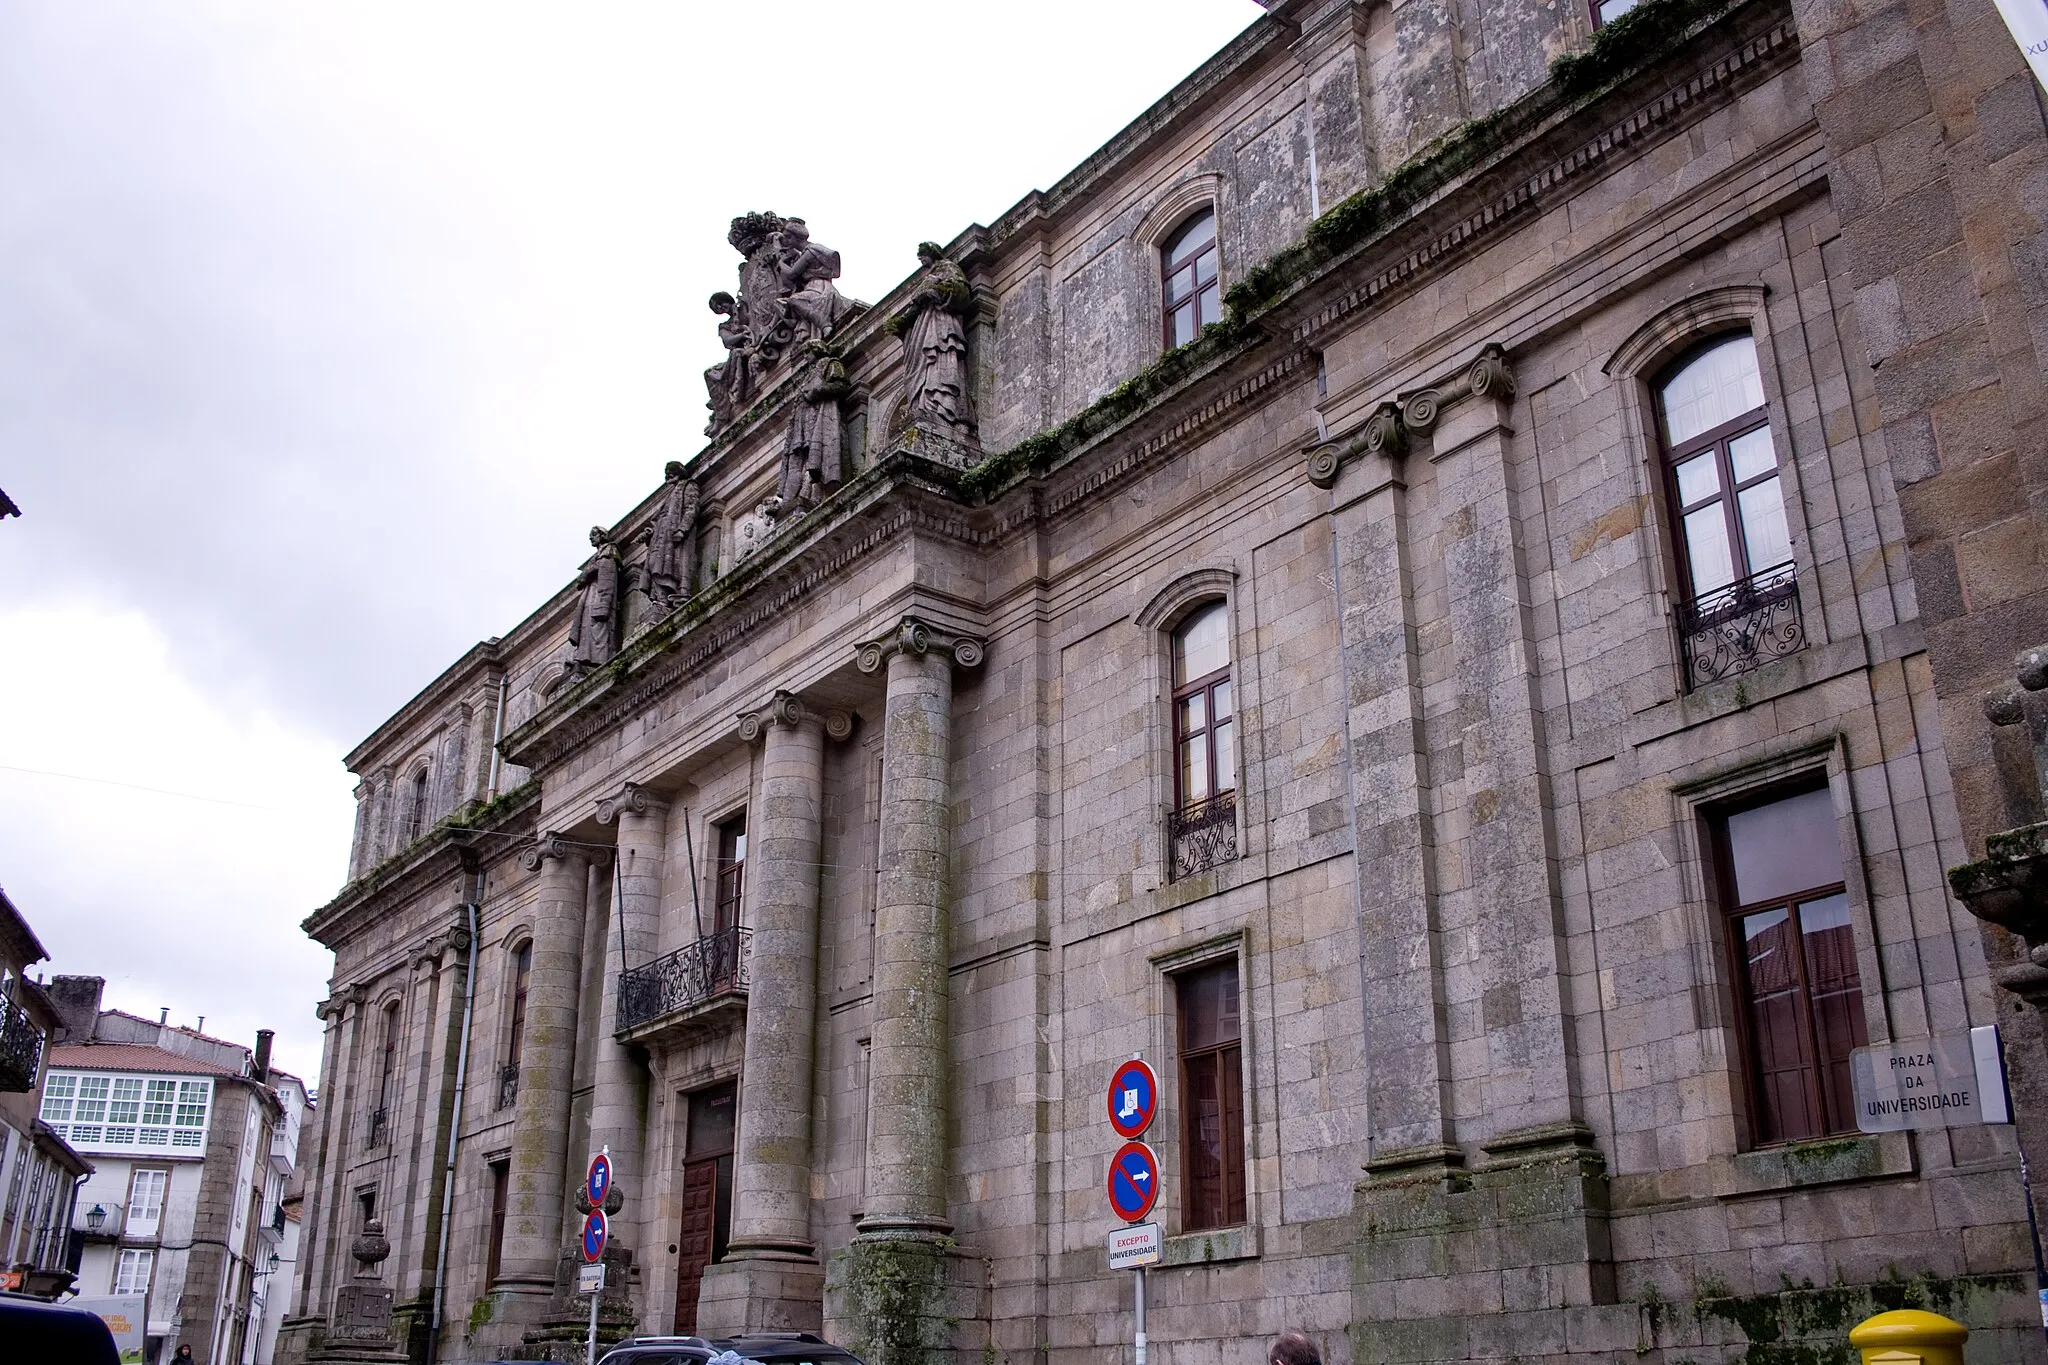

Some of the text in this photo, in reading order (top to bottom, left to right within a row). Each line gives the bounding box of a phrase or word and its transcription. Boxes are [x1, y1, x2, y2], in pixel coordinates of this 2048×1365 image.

[1890, 1053, 1935, 1070] PRAZA
[1906, 1076, 1924, 1089] DA
[1868, 1092, 1971, 1116] UNIVERSIDADE
[1117, 1235, 1149, 1247] EXCEPTO
[1110, 1245, 1157, 1260] UNIVERSIDADE
